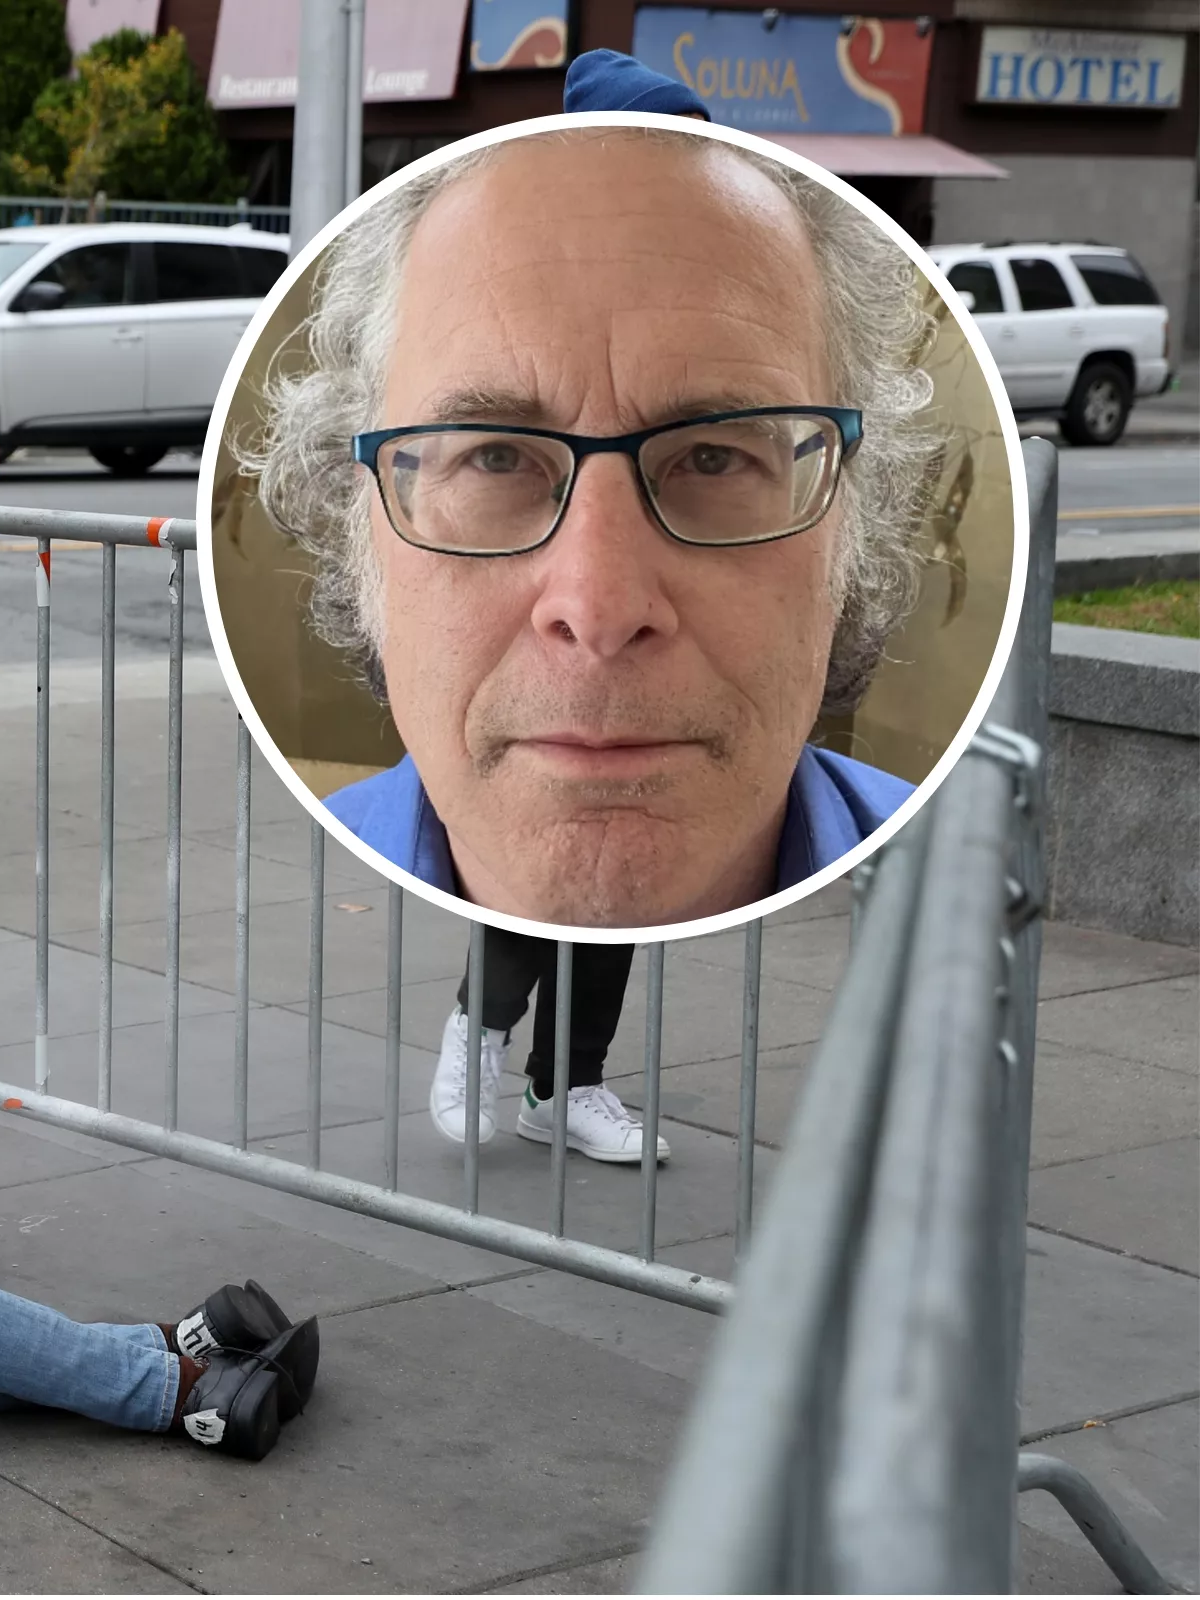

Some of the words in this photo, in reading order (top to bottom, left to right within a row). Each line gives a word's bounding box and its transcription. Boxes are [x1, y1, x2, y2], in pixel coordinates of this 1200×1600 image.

[219, 75, 298, 98] Restauran
[365, 68, 428, 95] Lounge
[985, 52, 1175, 106] HOTEL
[183, 1323, 212, 1356] 14
[196, 1420, 215, 1439] 14
